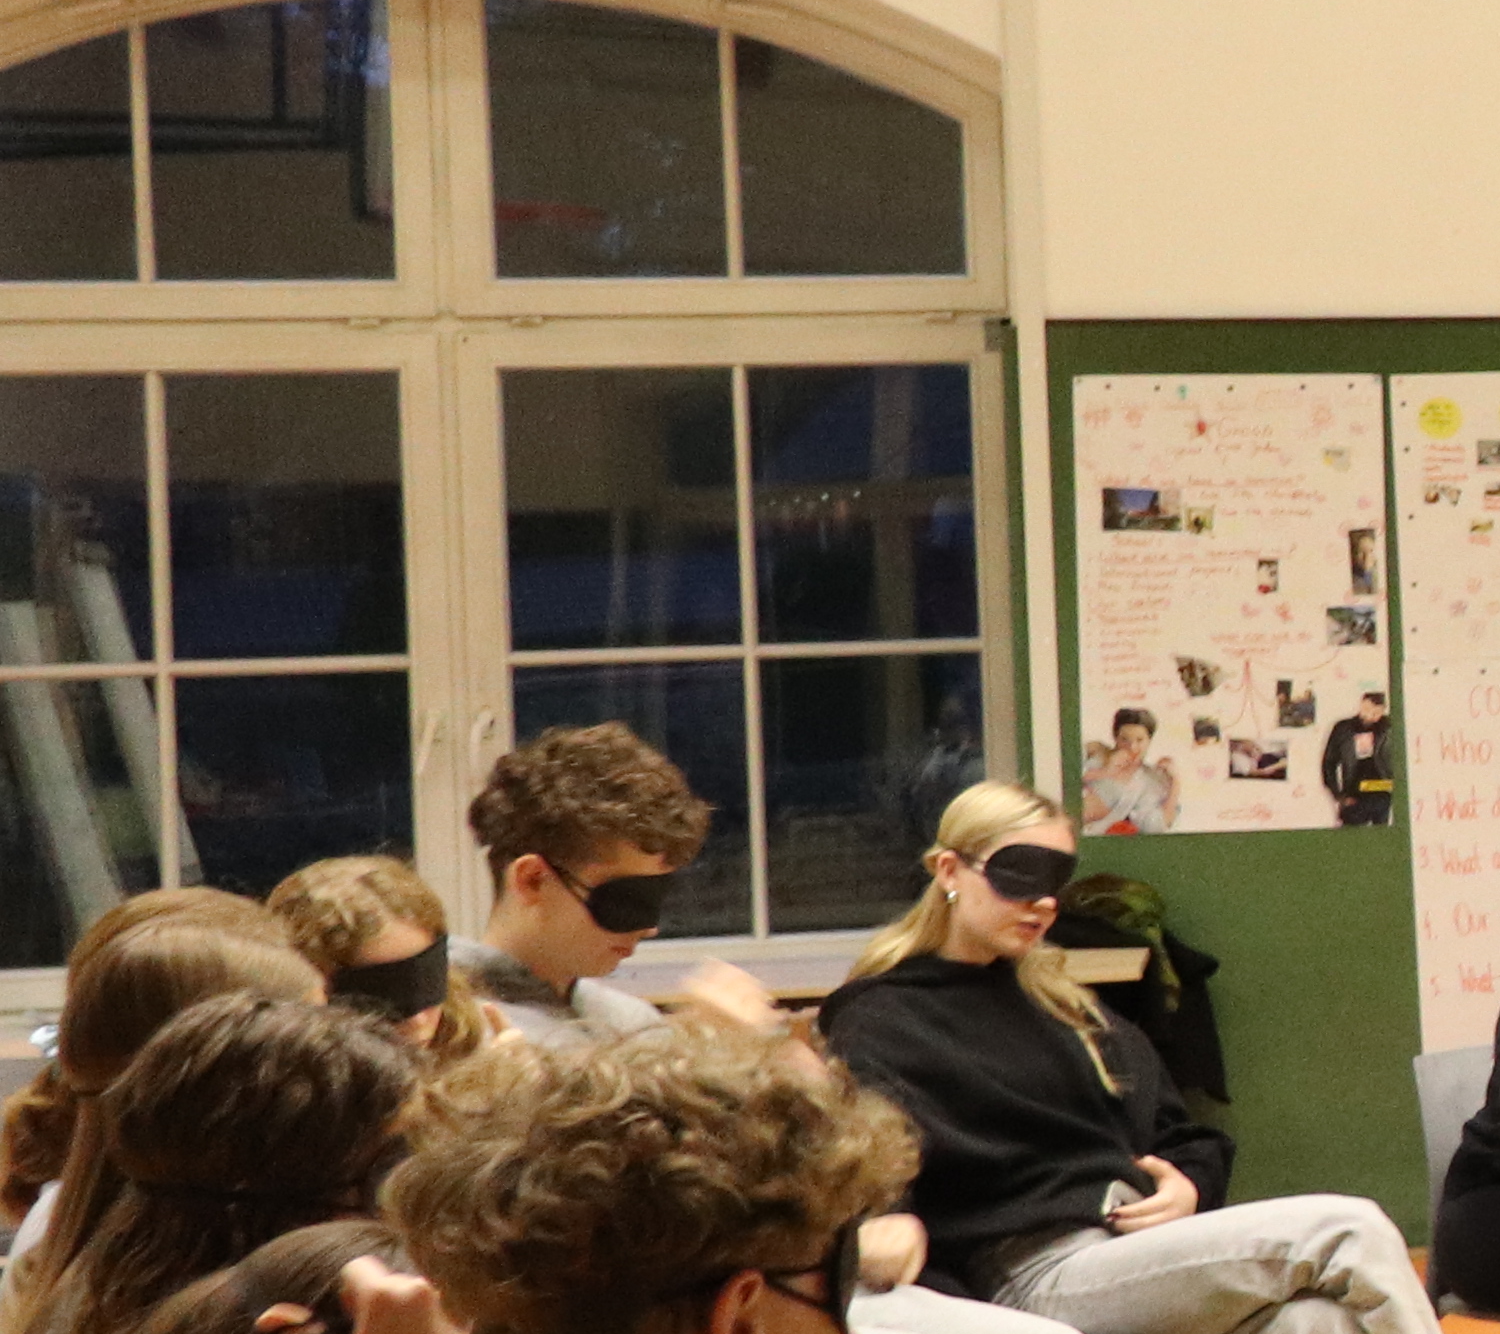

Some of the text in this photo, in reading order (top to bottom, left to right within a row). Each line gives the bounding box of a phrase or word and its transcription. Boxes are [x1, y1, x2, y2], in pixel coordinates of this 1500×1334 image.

[1440, 729, 1492, 765] Who
[1436, 785, 1482, 820] What
[1439, 839, 1482, 875] What
[1452, 901, 1490, 937] Our
